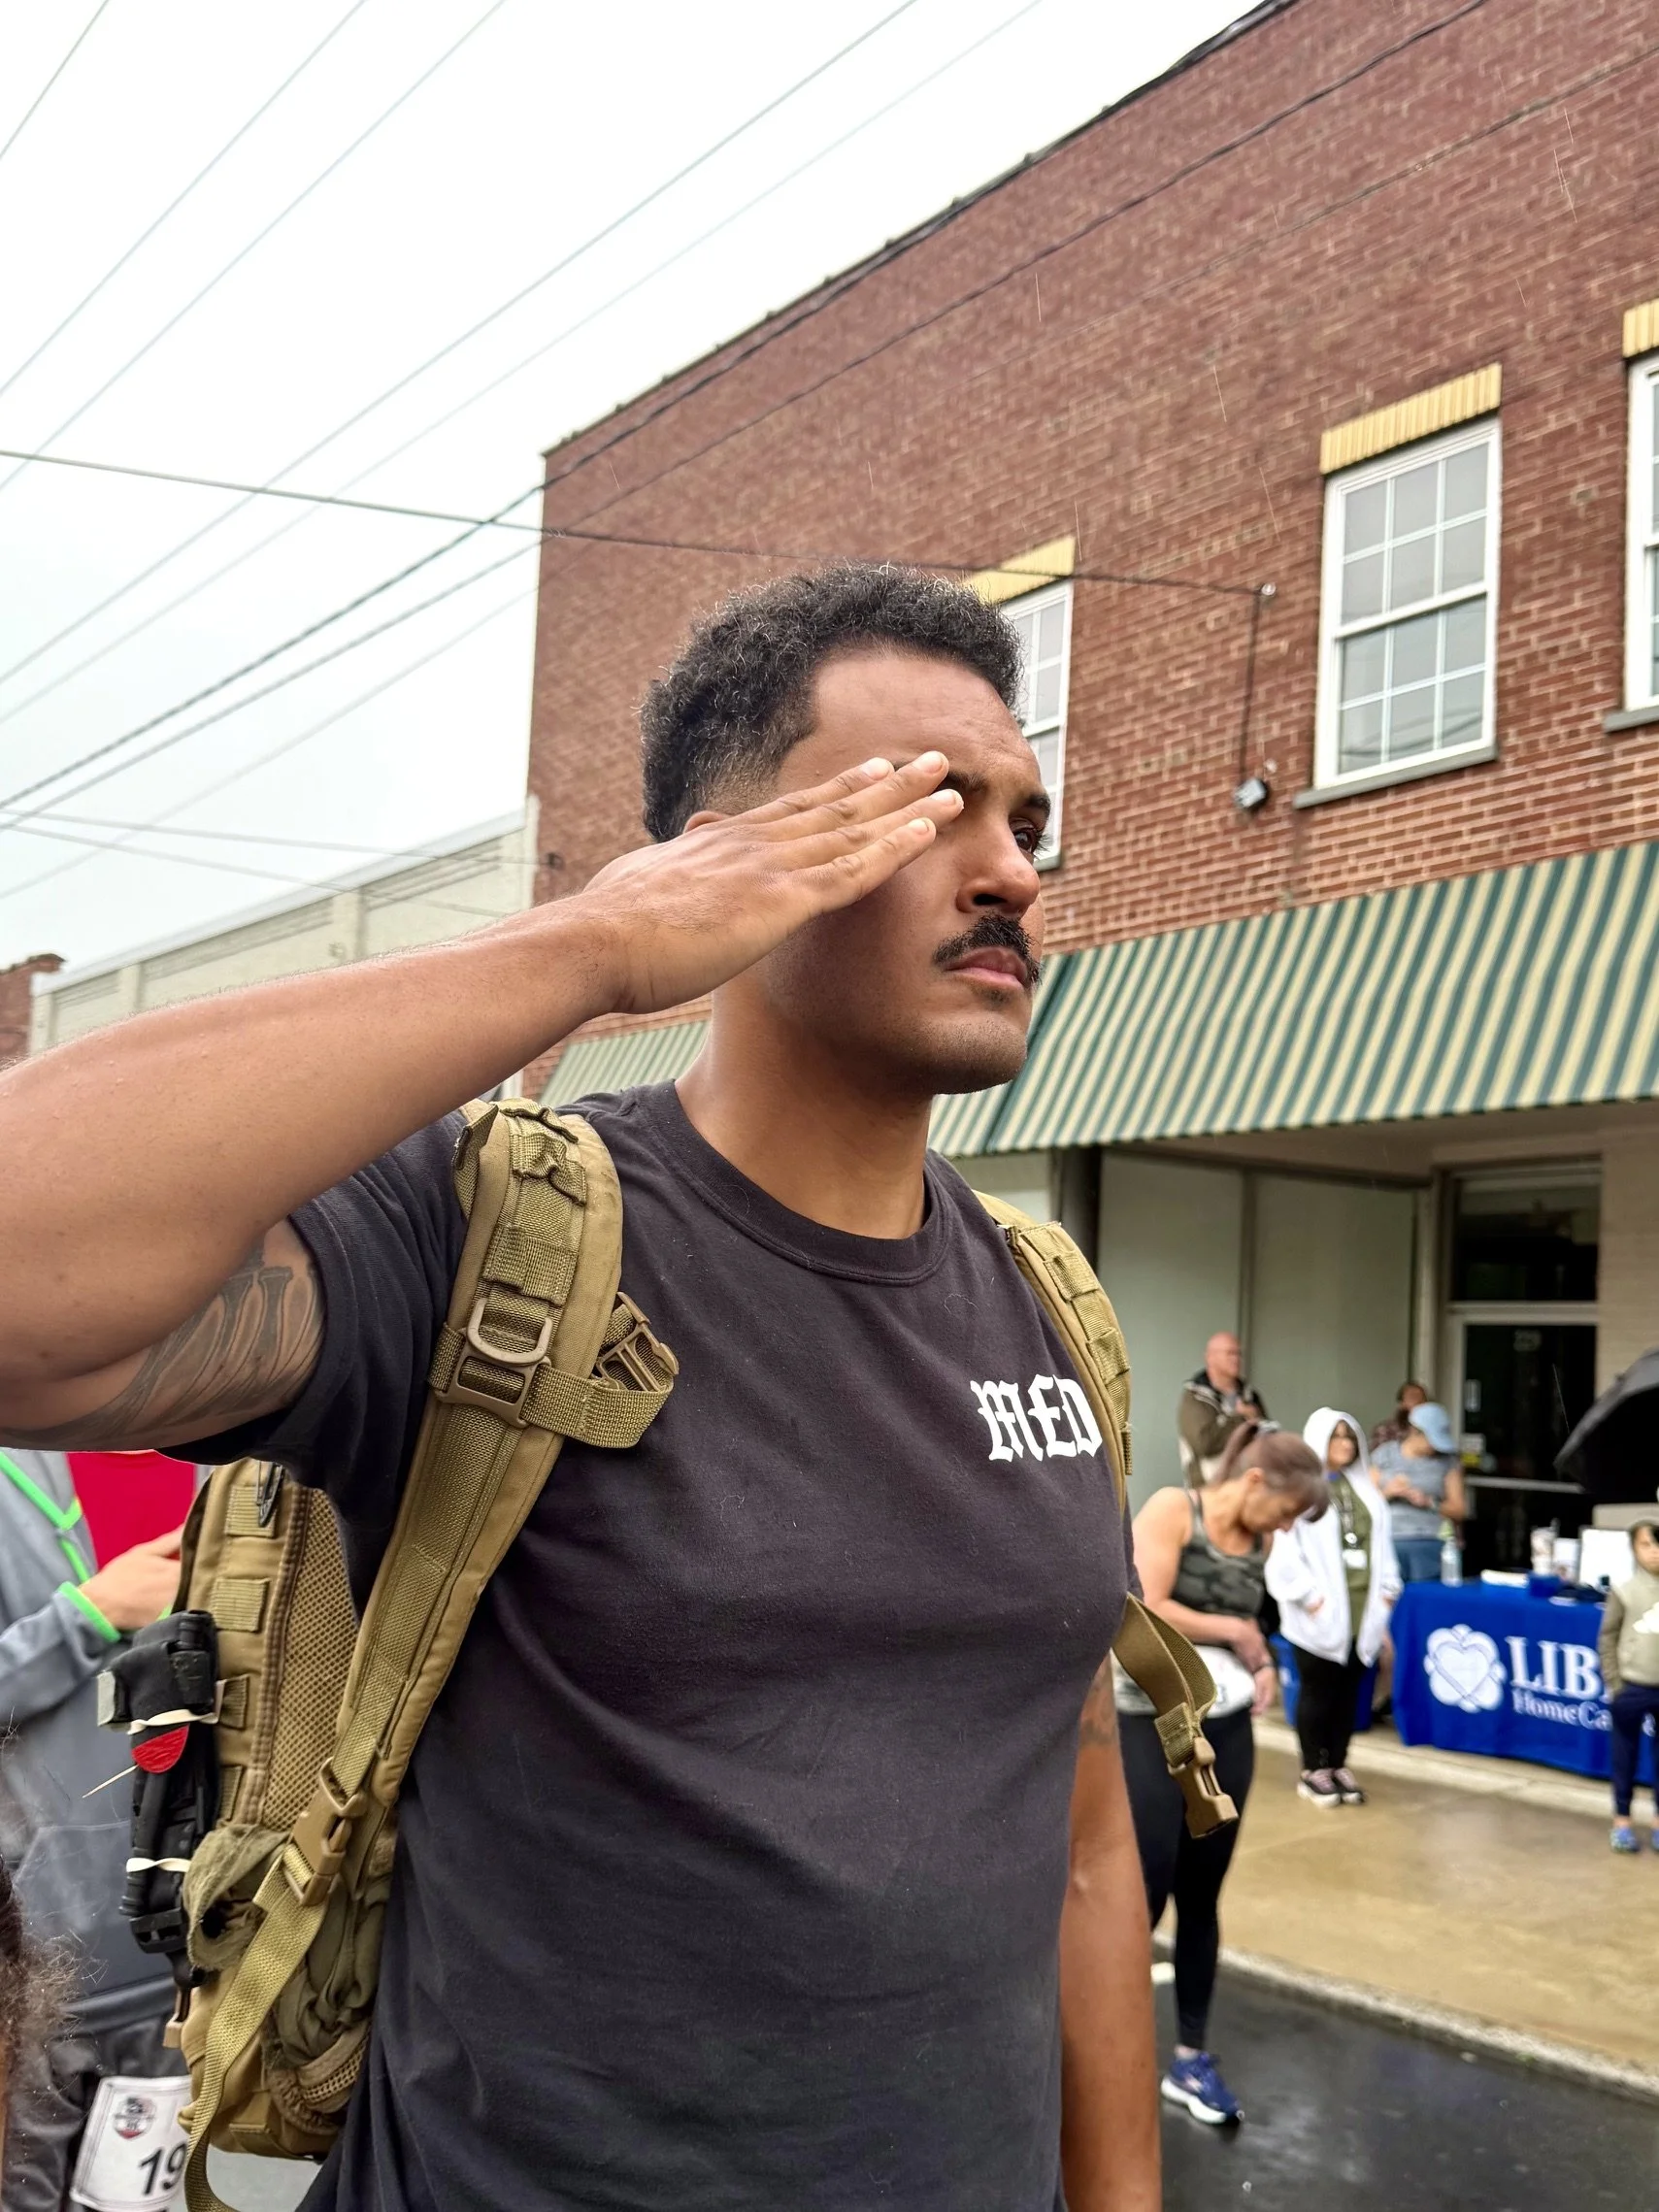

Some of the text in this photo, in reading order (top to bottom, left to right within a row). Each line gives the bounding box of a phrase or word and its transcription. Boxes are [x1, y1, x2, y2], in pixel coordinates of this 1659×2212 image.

[970, 1373, 1103, 1462] MED
[1505, 1635, 1613, 1703] LIB
[139, 2142, 187, 2195] 19
